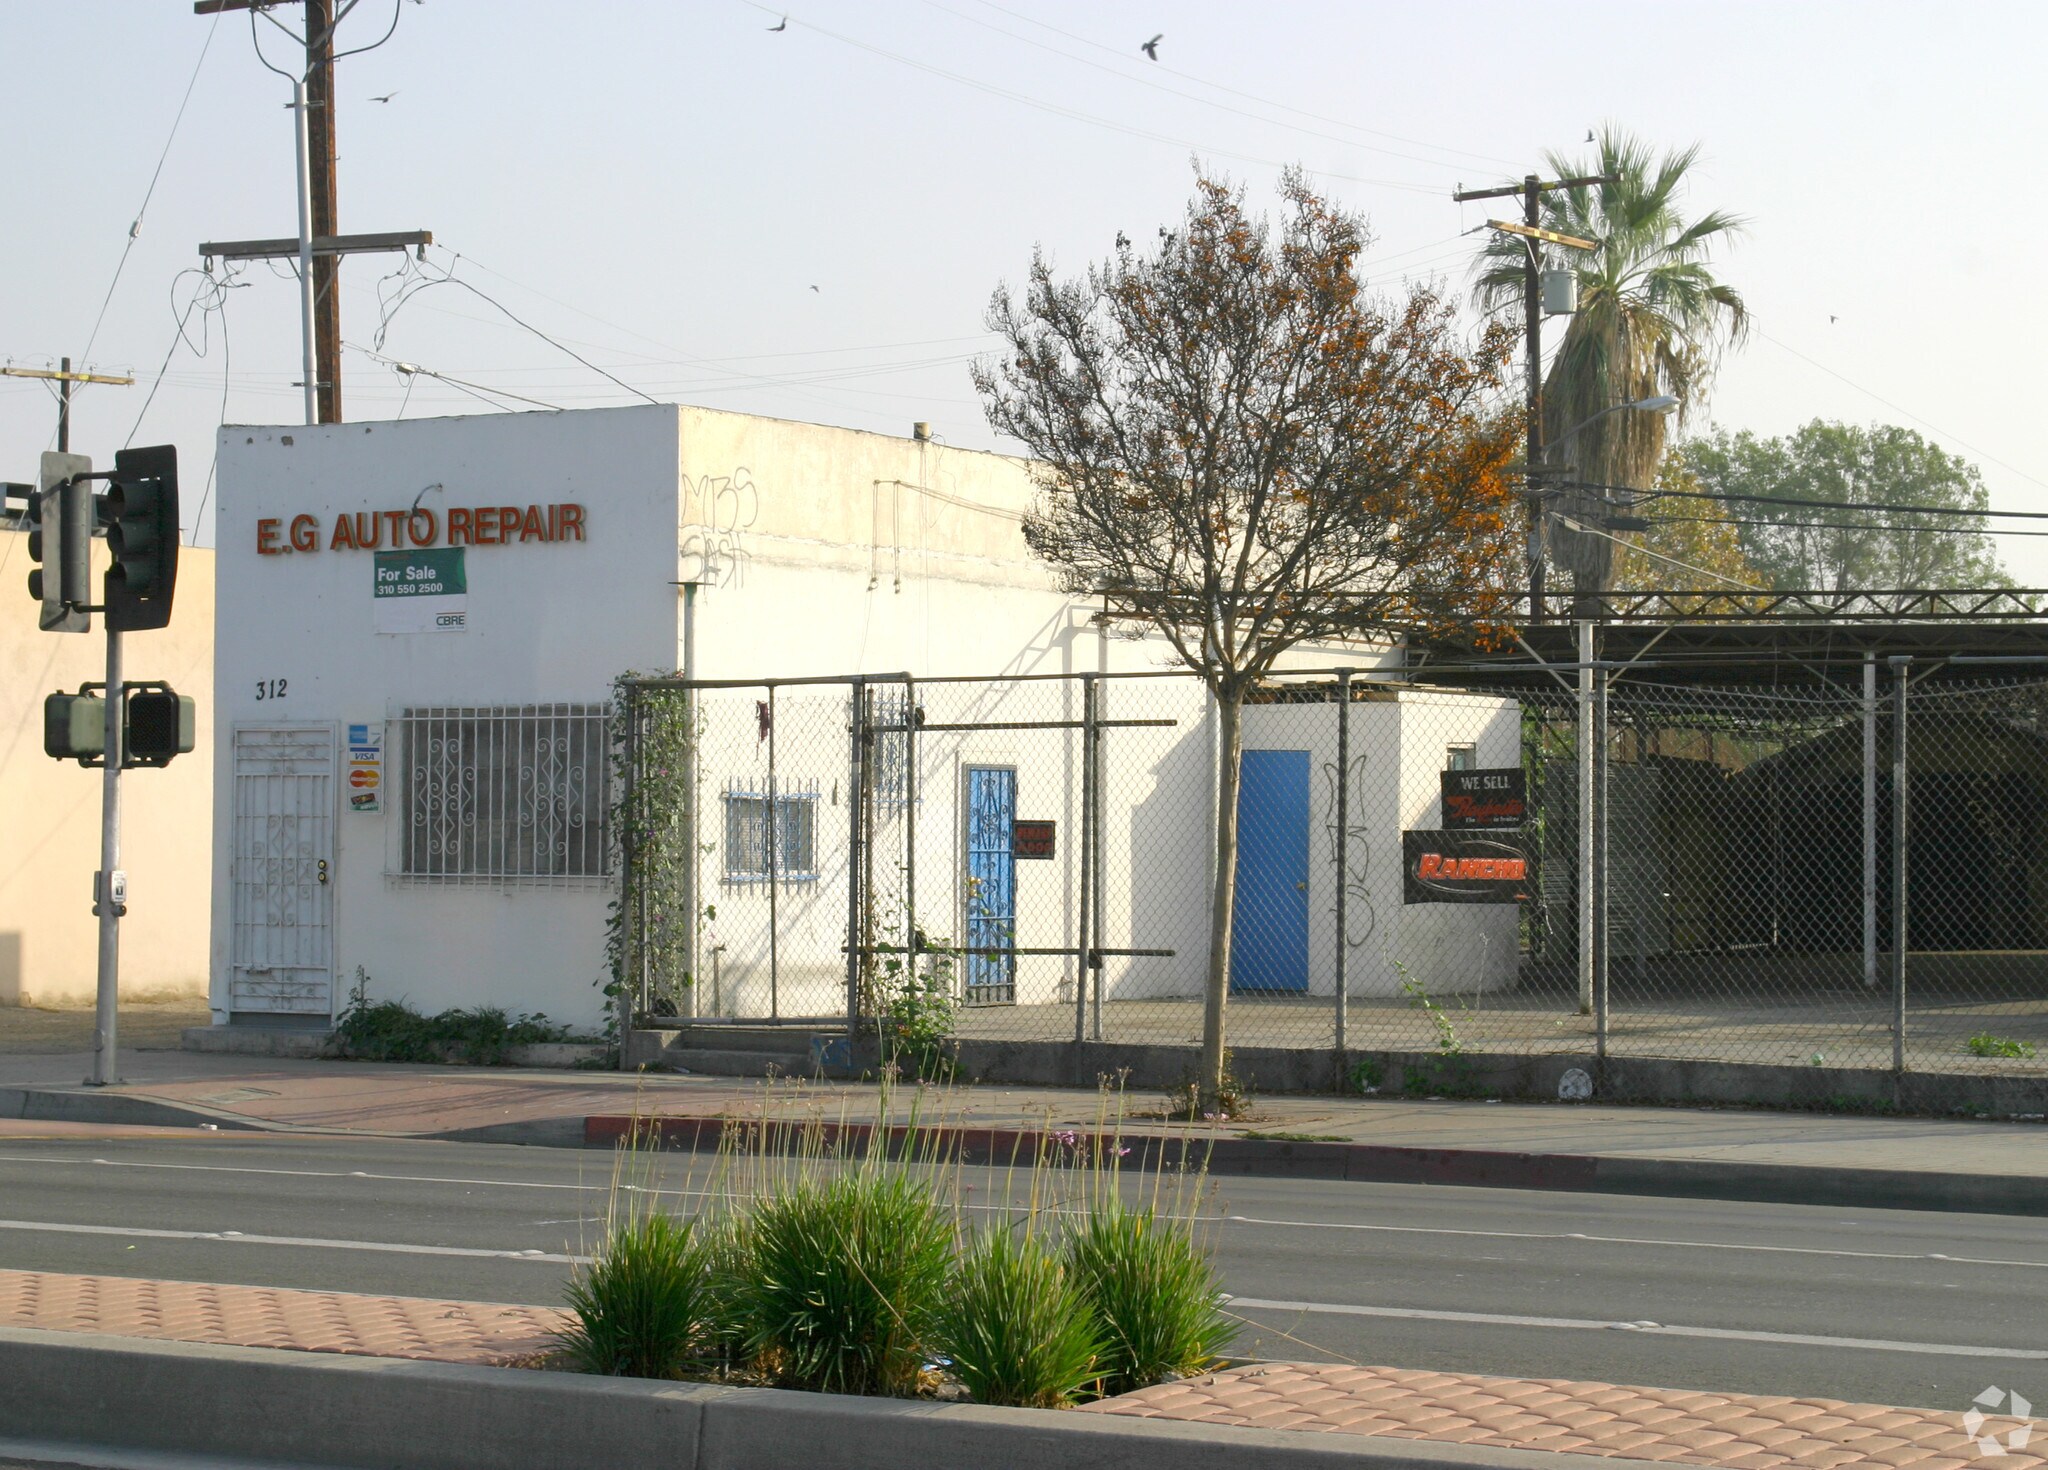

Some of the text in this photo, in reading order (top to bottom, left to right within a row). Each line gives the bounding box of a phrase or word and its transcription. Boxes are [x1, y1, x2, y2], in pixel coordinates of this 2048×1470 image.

[257, 503, 587, 555] E.G AUTO REPAIR
[377, 565, 437, 582] For Sale
[378, 582, 443, 595] 310 550 2500
[436, 615, 466, 626] CBRE
[255, 678, 288, 701] 312
[354, 752, 375, 761] VISA
[1460, 775, 1512, 790] WE SELL
[1417, 852, 1527, 880] RANCHO
